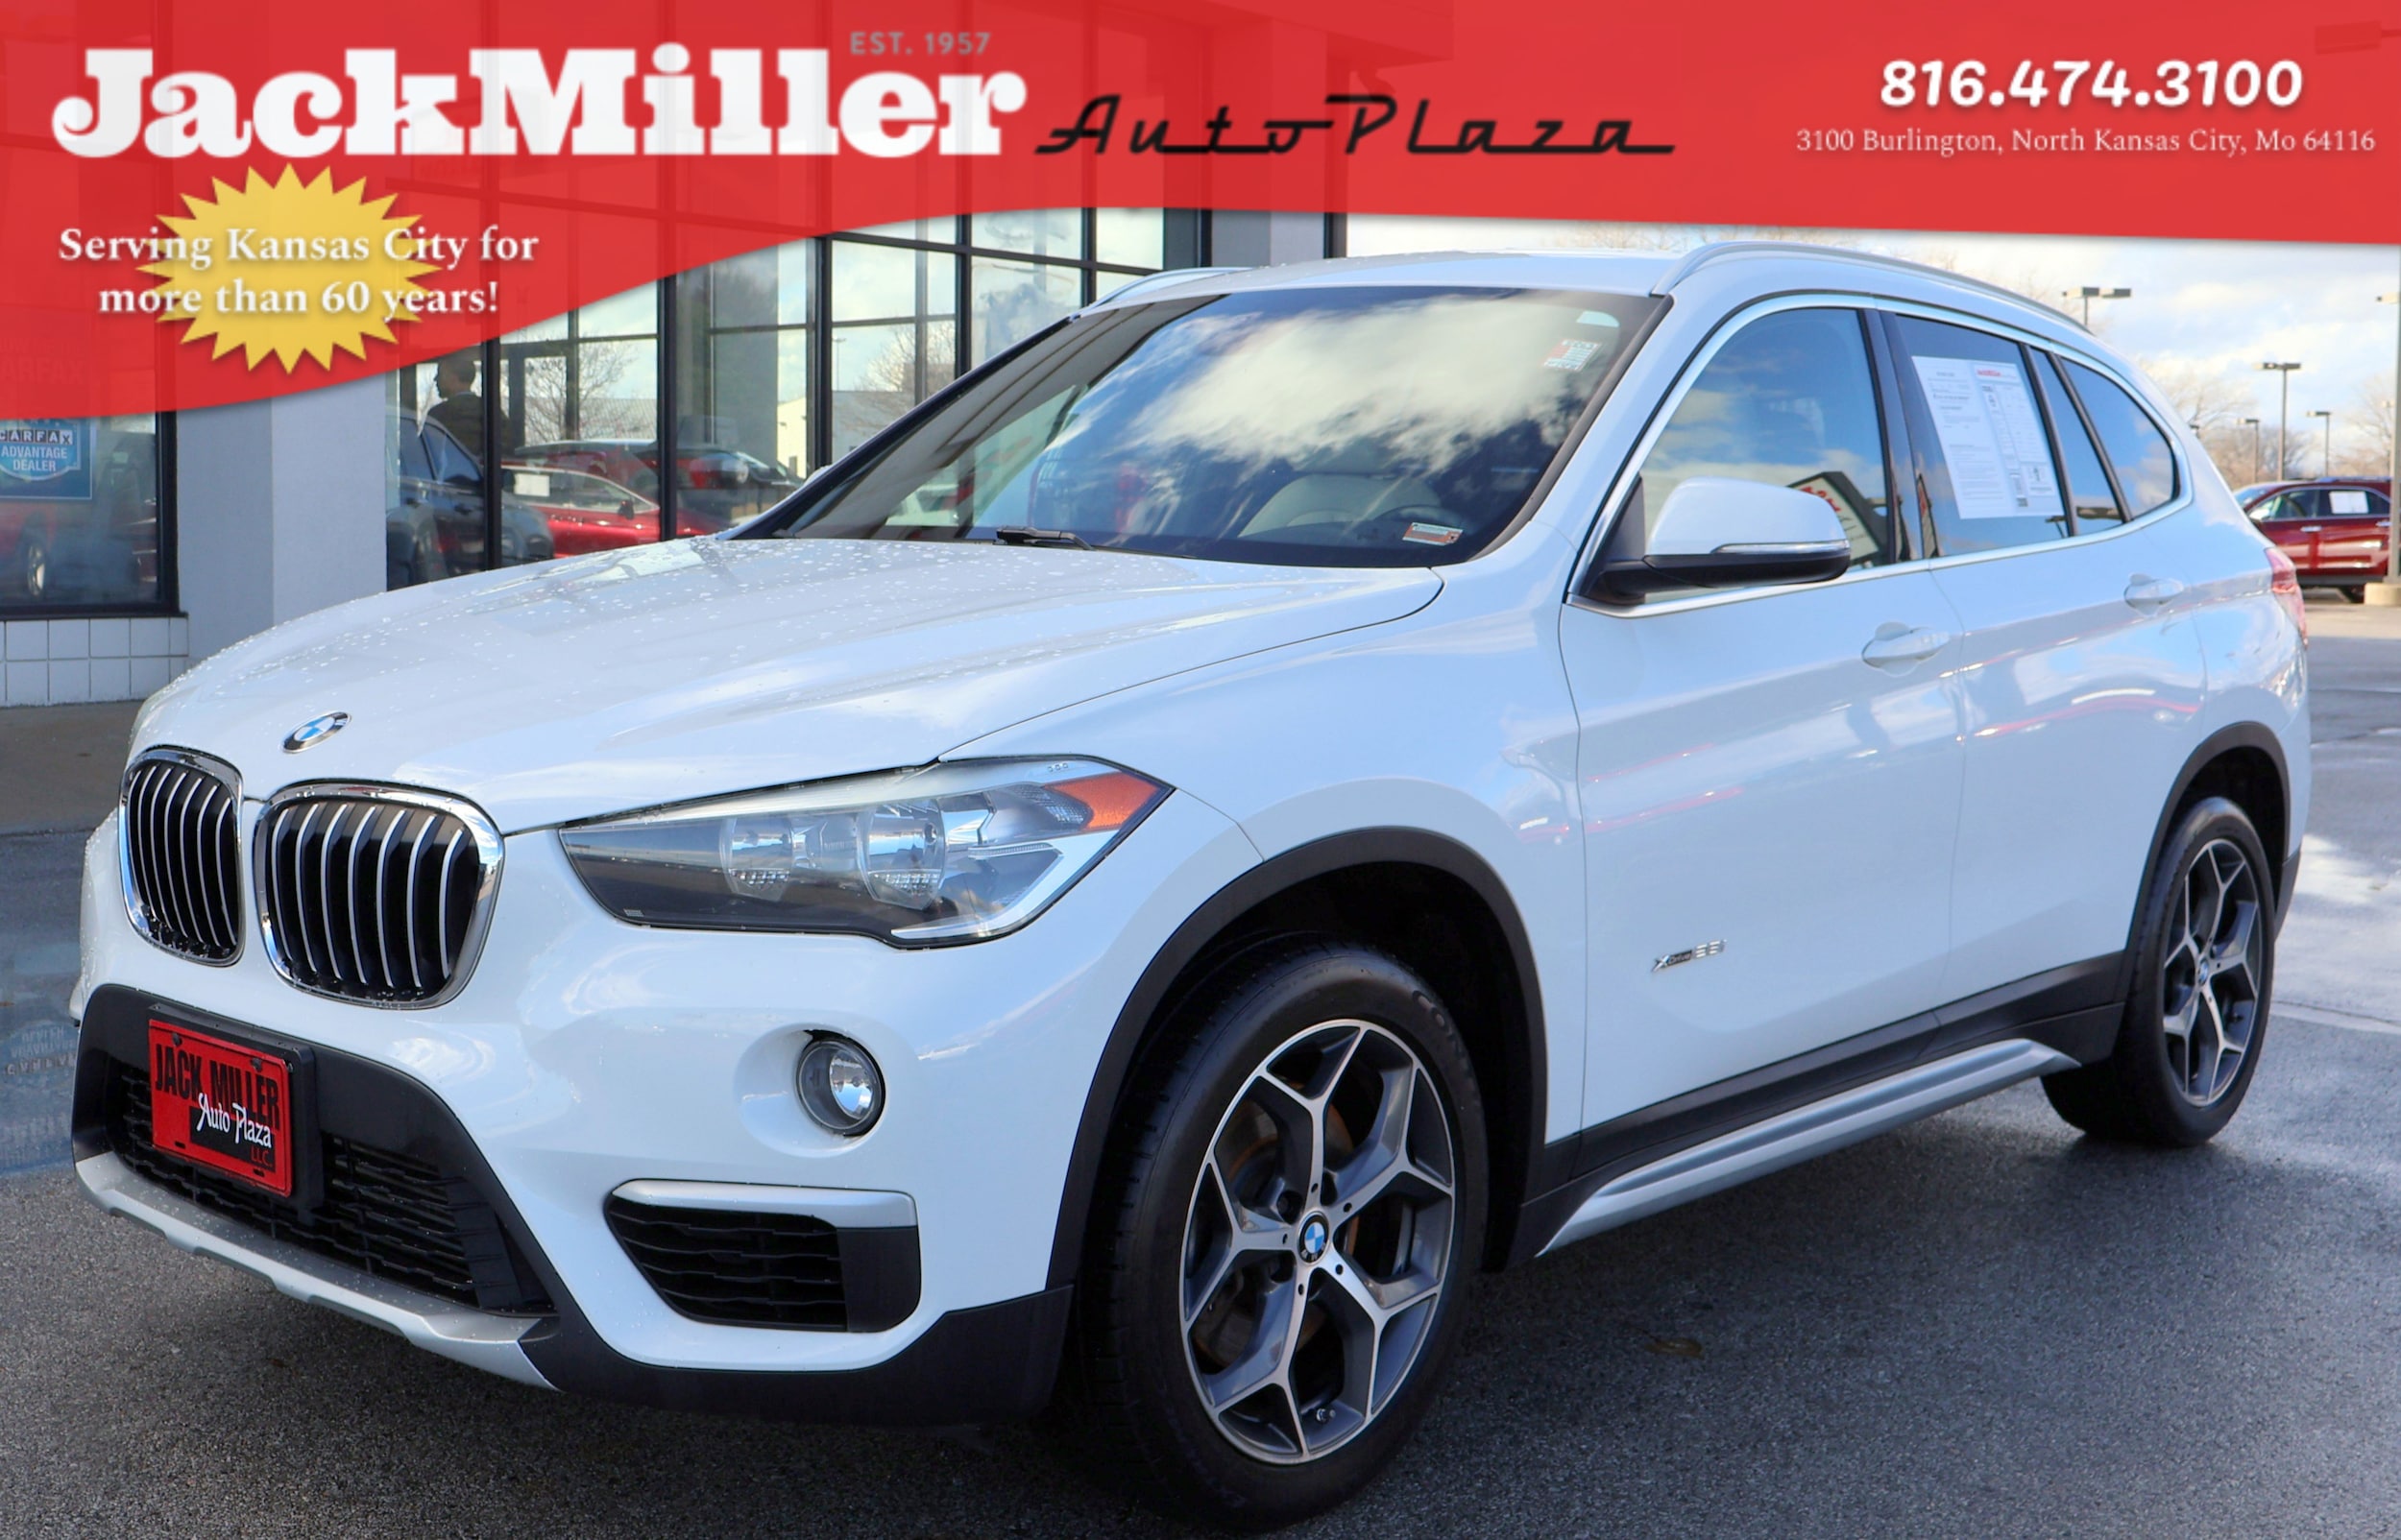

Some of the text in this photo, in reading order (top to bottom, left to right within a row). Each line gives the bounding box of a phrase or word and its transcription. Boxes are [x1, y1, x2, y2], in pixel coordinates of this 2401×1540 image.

[1, 445, 68, 459] ADVANTAGE
[12, 459, 56, 471] DEALER
[156, 1043, 203, 1103] JACK
[209, 1059, 280, 1131] MILLER
[196, 1092, 272, 1148] Auto Plaza
